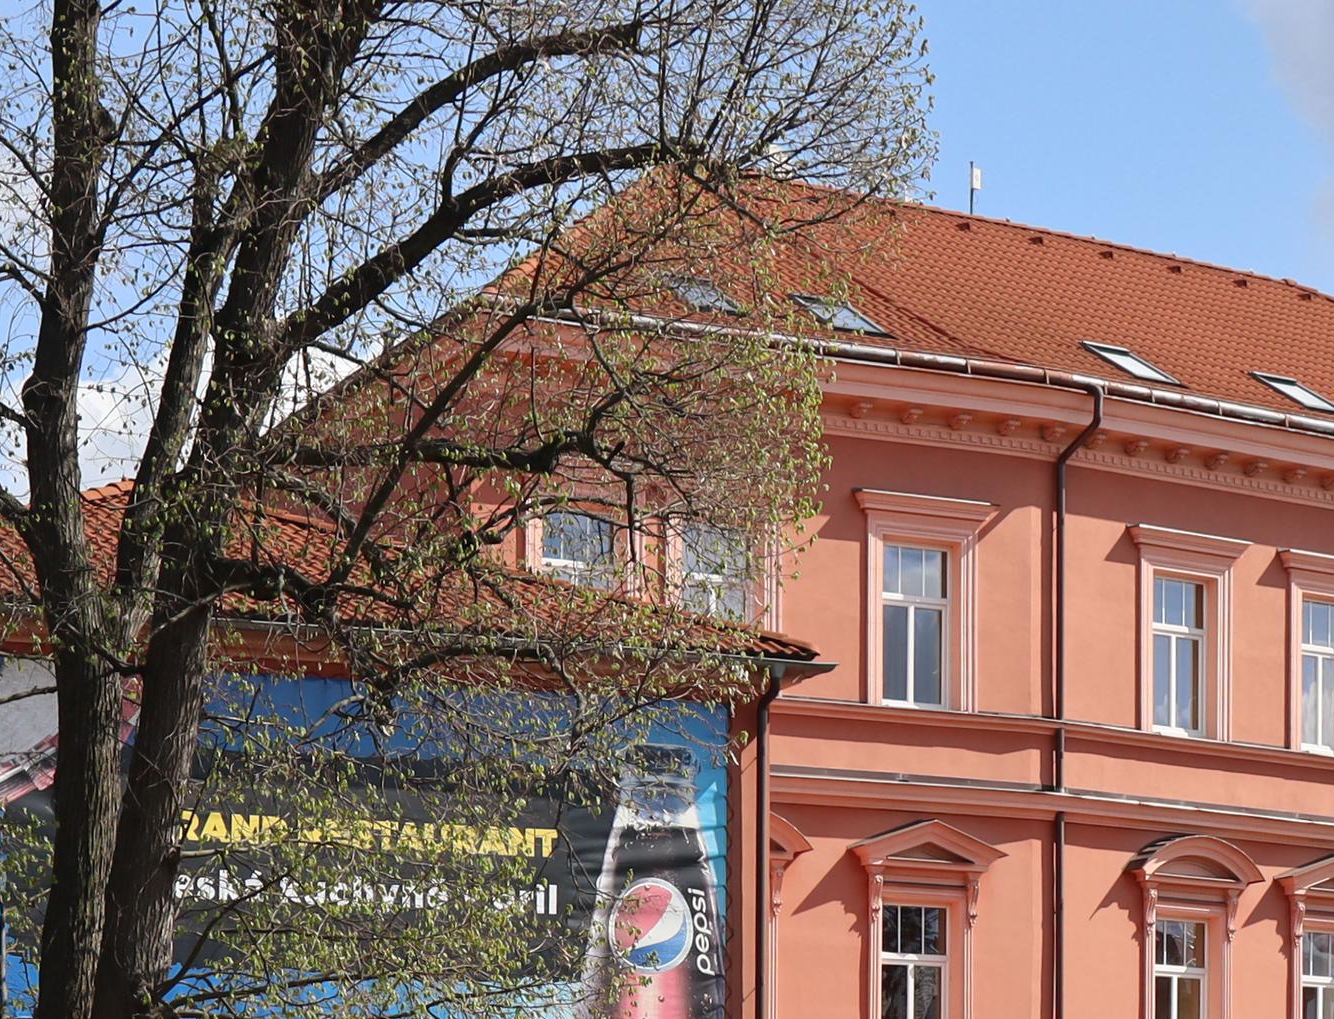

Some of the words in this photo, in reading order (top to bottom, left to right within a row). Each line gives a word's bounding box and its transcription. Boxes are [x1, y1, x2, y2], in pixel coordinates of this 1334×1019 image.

[178, 809, 288, 844] RAND
[174, 868, 267, 902] eská
[687, 887, 716, 976] pepsi
